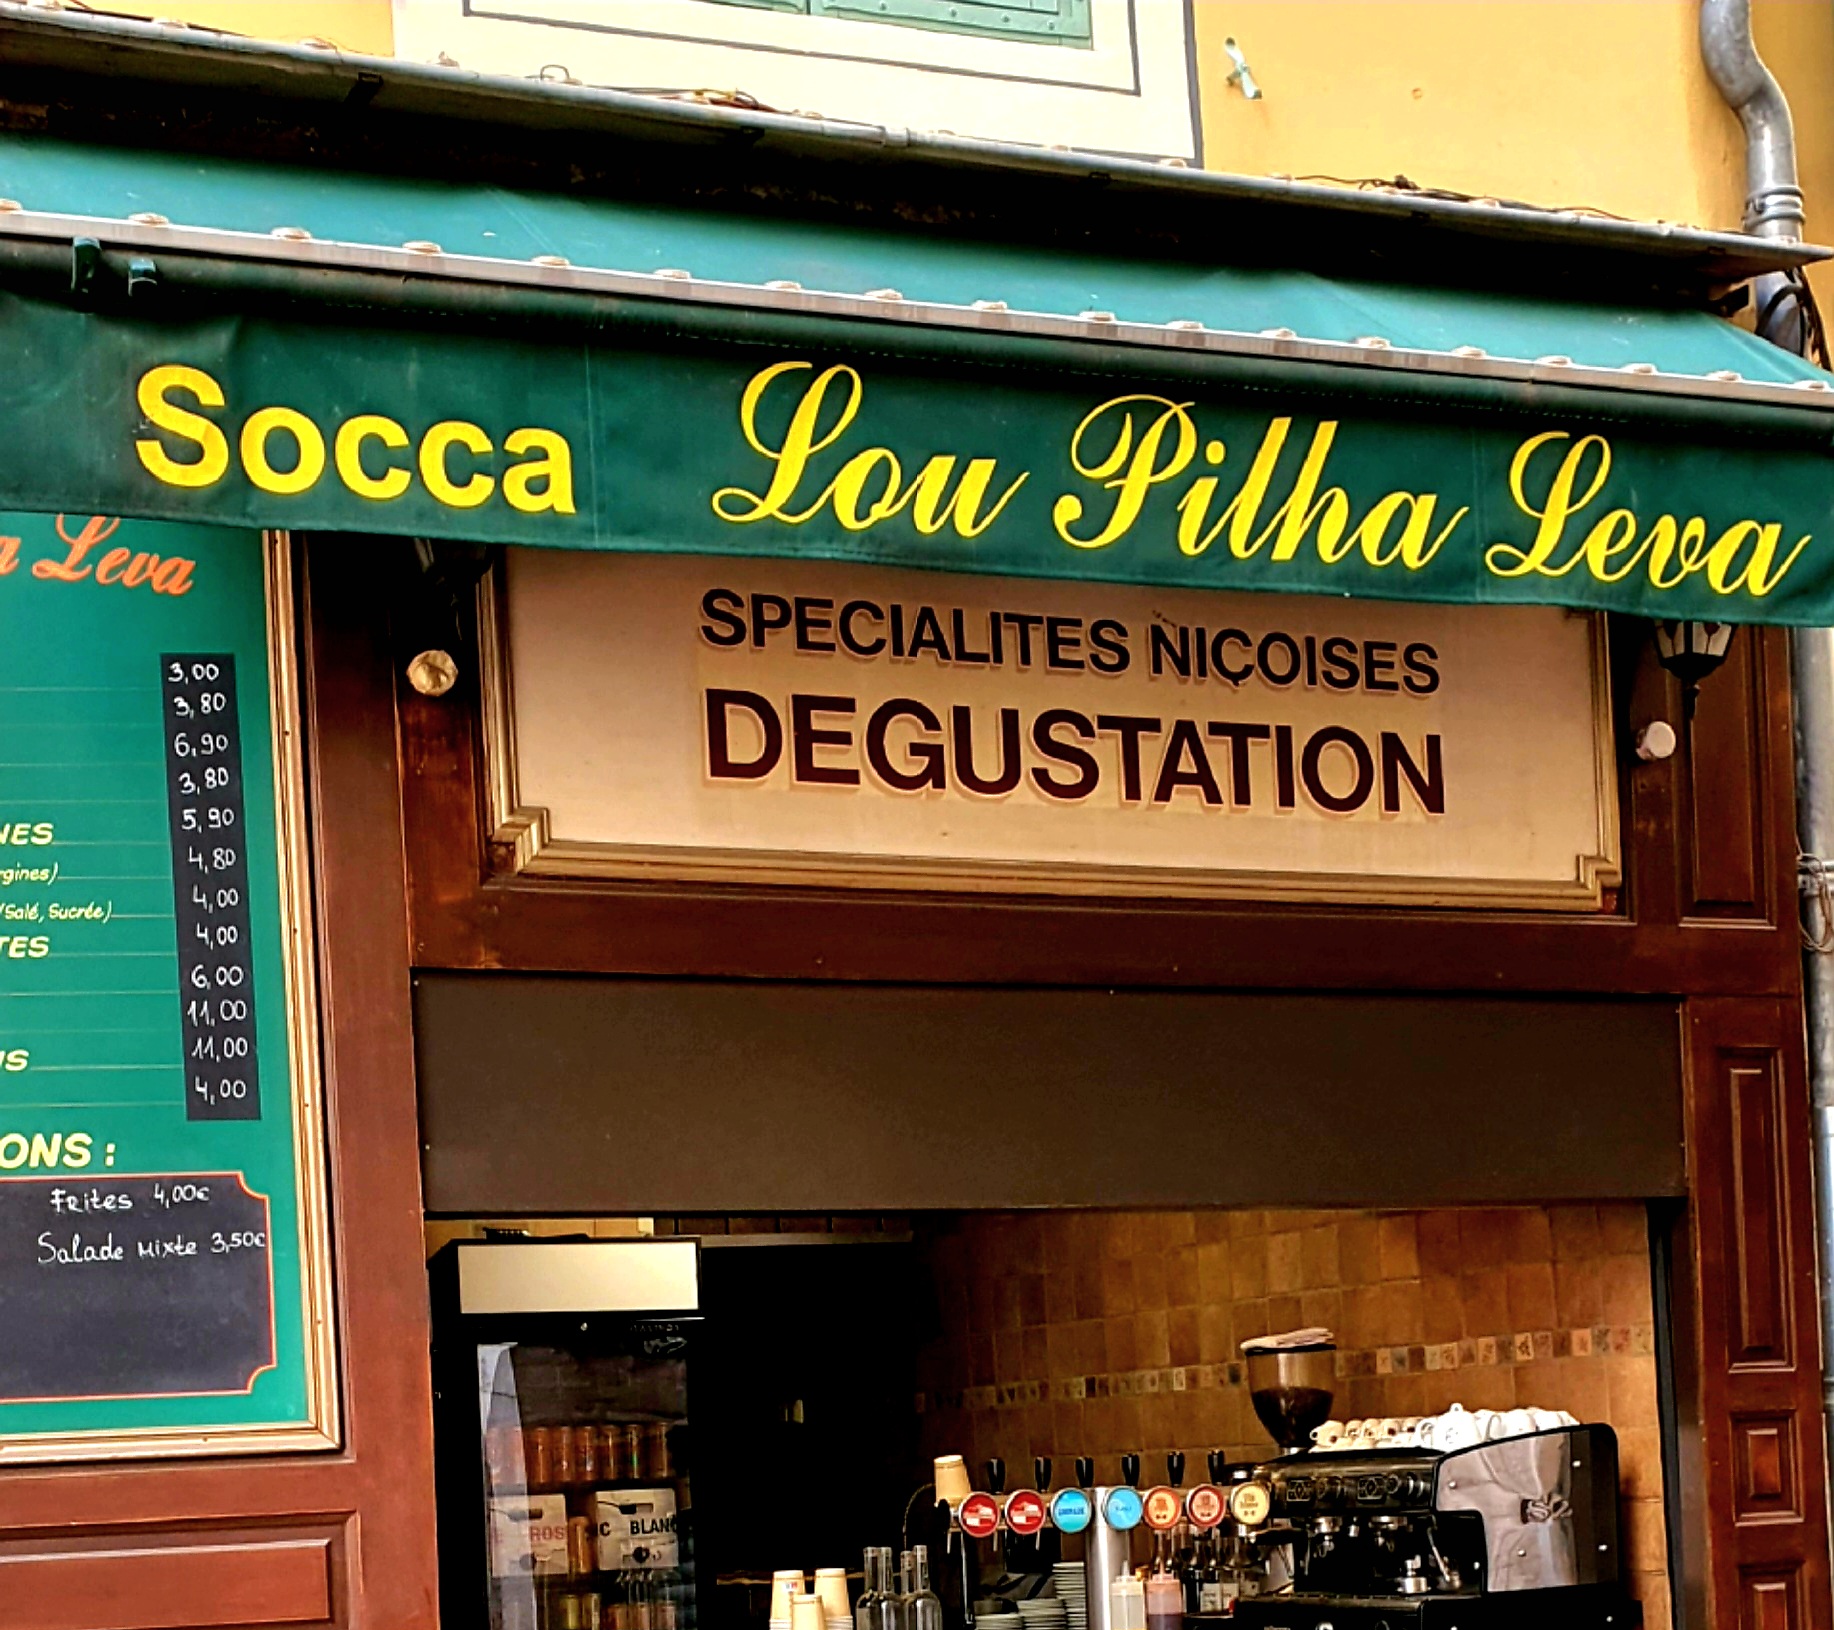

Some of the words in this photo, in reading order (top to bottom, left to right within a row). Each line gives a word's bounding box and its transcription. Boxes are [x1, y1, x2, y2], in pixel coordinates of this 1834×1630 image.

[136, 364, 576, 515] Socca
[712, 361, 1030, 538] Lou
[1053, 393, 1469, 569] Pilha
[1485, 431, 1812, 596] Leva
[32, 513, 196, 596] Leva
[701, 588, 1131, 674] SPECIALITES
[1150, 618, 1441, 694] NIÇOISES
[168, 663, 220, 685] 3,00
[174, 692, 227, 718] 3,80
[174, 732, 229, 757] 6,90
[706, 688, 1445, 814] DEGUSTATION
[178, 767, 230, 795] 3,80
[181, 807, 235, 833] 5,90
[188, 845, 236, 875] 4,80
[49, 900, 112, 924] Sucrée)
[193, 884, 239, 914] 4,00
[196, 922, 239, 951] 4,00
[191, 964, 244, 990] 6,00
[187, 1000, 247, 1027] 11,00
[191, 1036, 249, 1063] 11,00
[194, 1076, 247, 1106] 4,00
[154, 1183, 210, 1208] 4,00€
[38, 1232, 124, 1264] Salade
[210, 1232, 266, 1254] 3,50€
